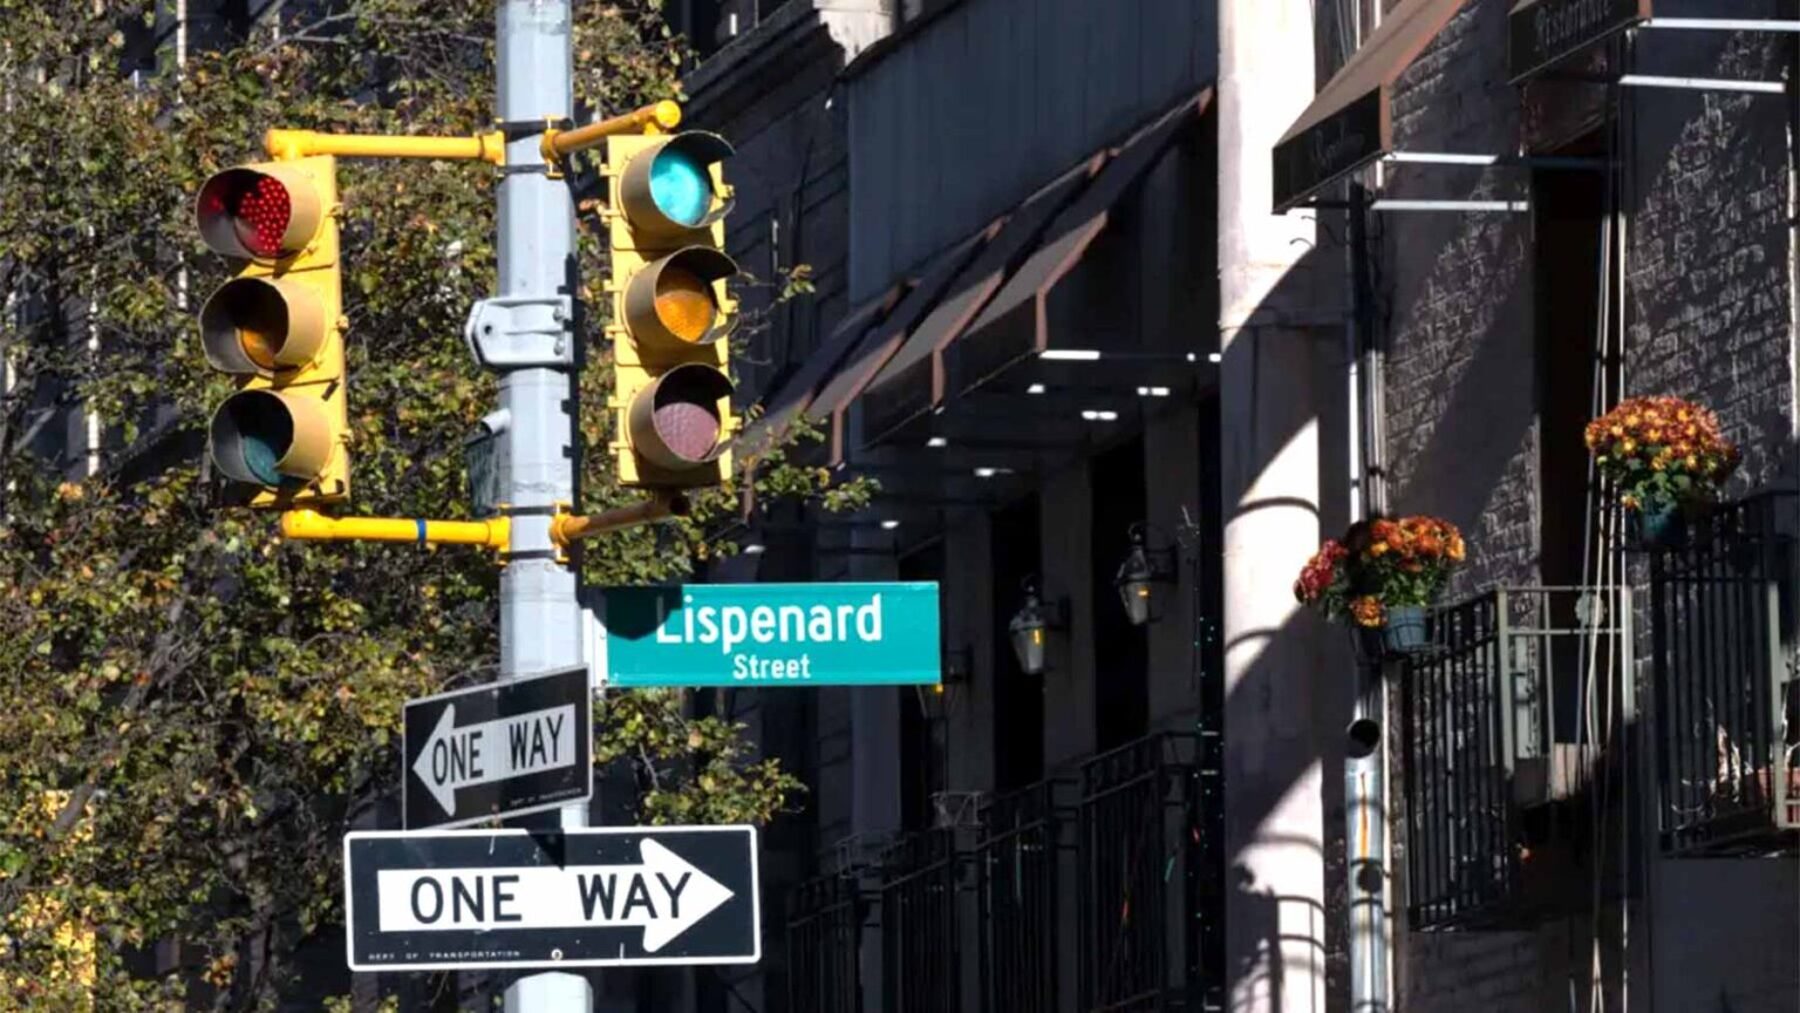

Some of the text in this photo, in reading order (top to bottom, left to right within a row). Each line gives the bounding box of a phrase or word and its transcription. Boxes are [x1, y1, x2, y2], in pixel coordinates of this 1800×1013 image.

[656, 592, 882, 655] Lispenard
[733, 653, 811, 681] Street
[432, 713, 565, 786] ONE WAY
[410, 871, 694, 925] ONE WAY
[404, 952, 419, 961] OF
[429, 949, 521, 960] TRANSPORTATION
